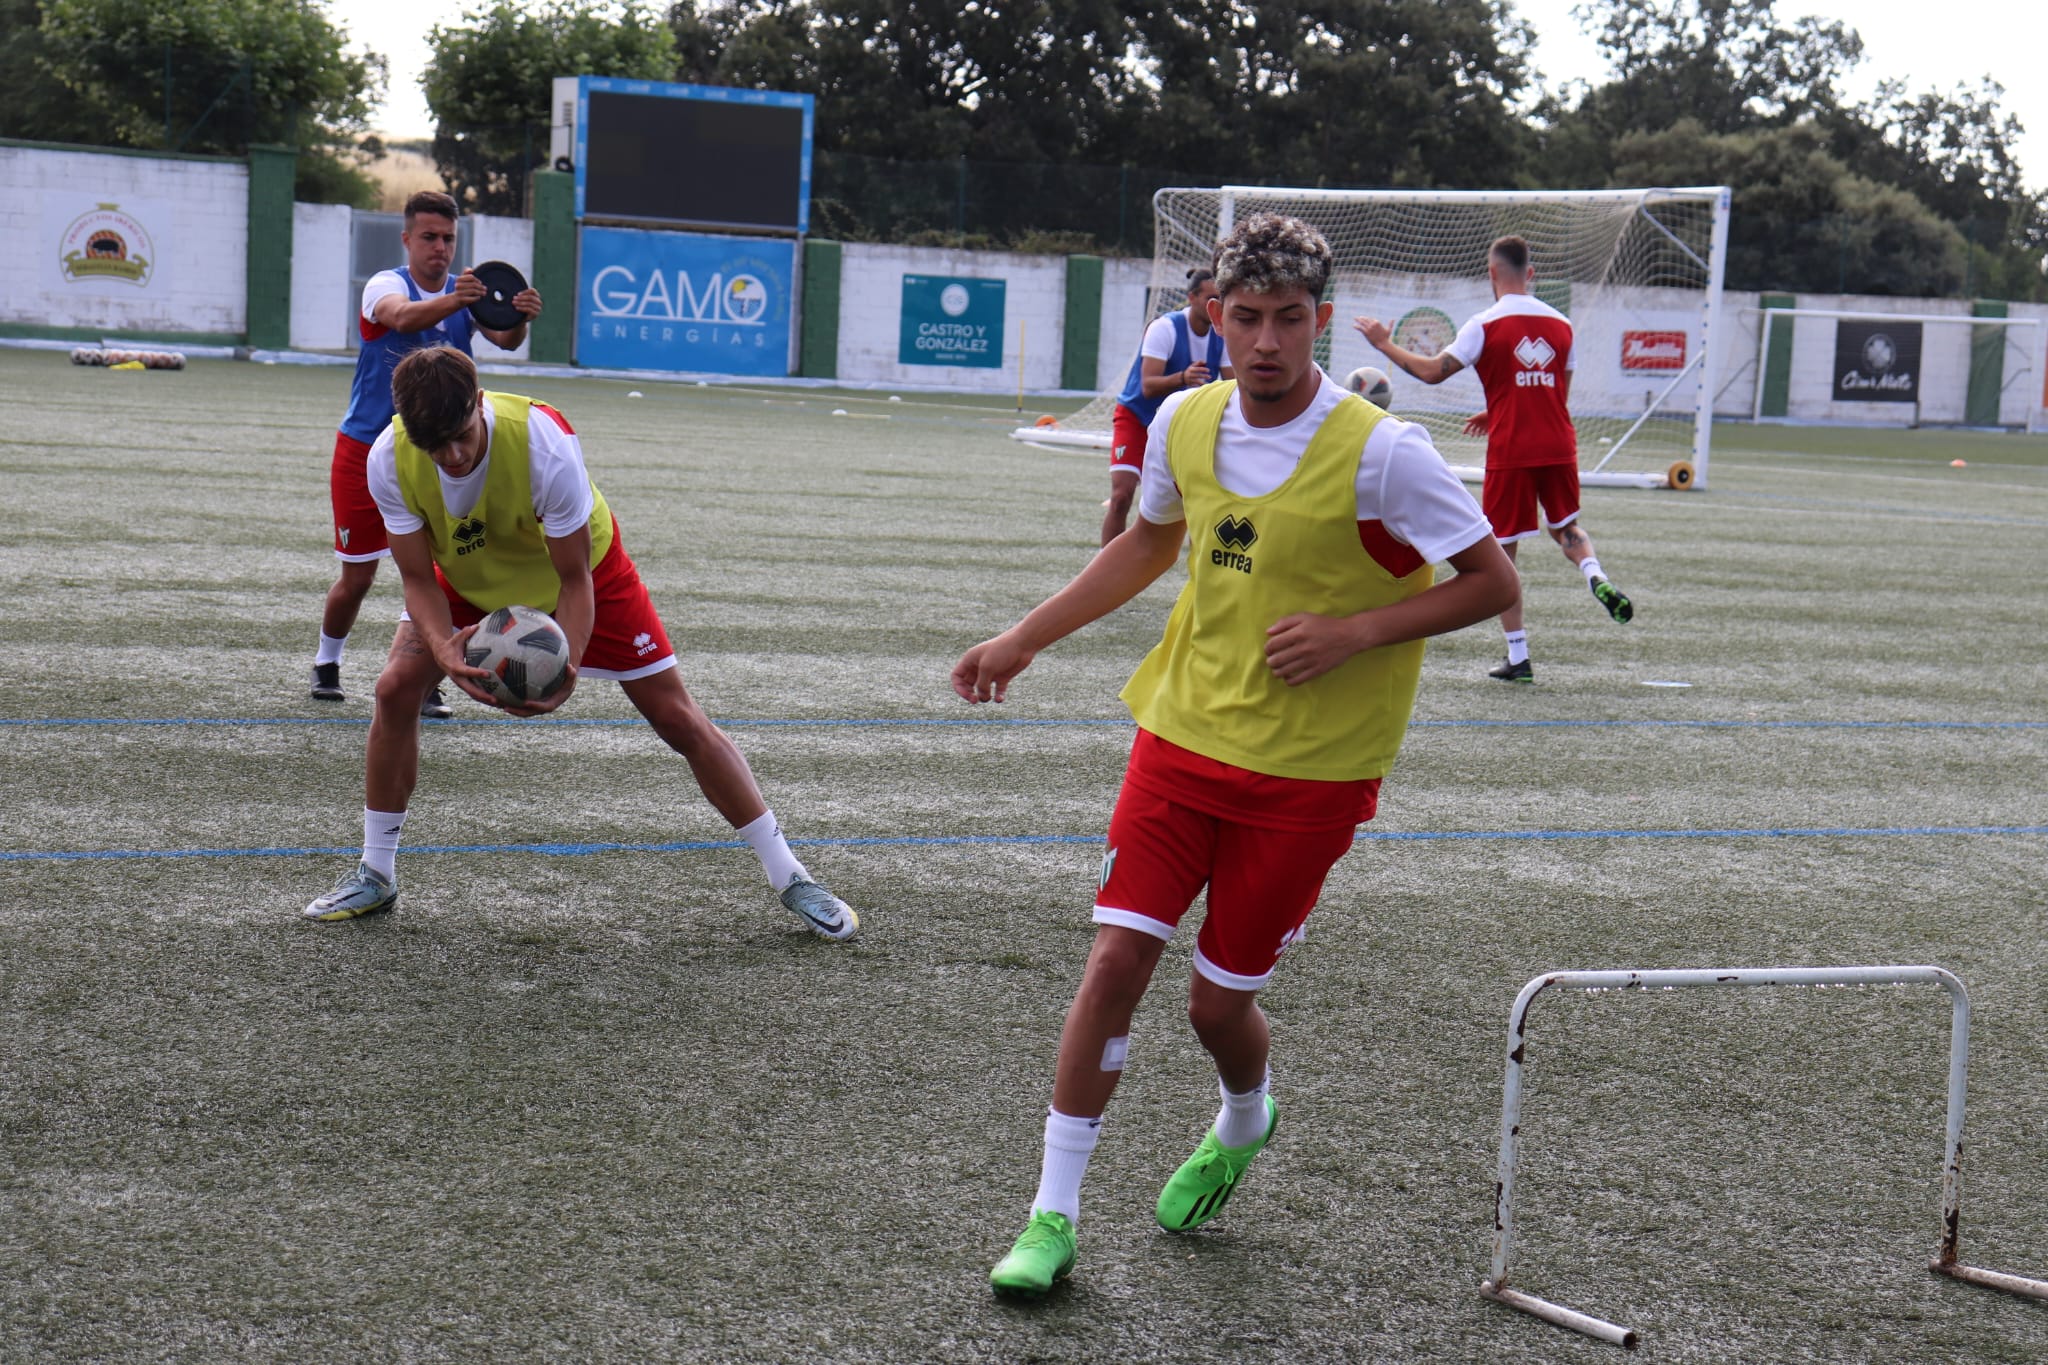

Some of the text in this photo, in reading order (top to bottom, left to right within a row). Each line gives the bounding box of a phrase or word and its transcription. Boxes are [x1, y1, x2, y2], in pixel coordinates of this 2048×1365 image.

[592, 265, 767, 323] GAMO
[918, 322, 986, 338] CASTRO Y
[1211, 548, 1252, 574] errea
